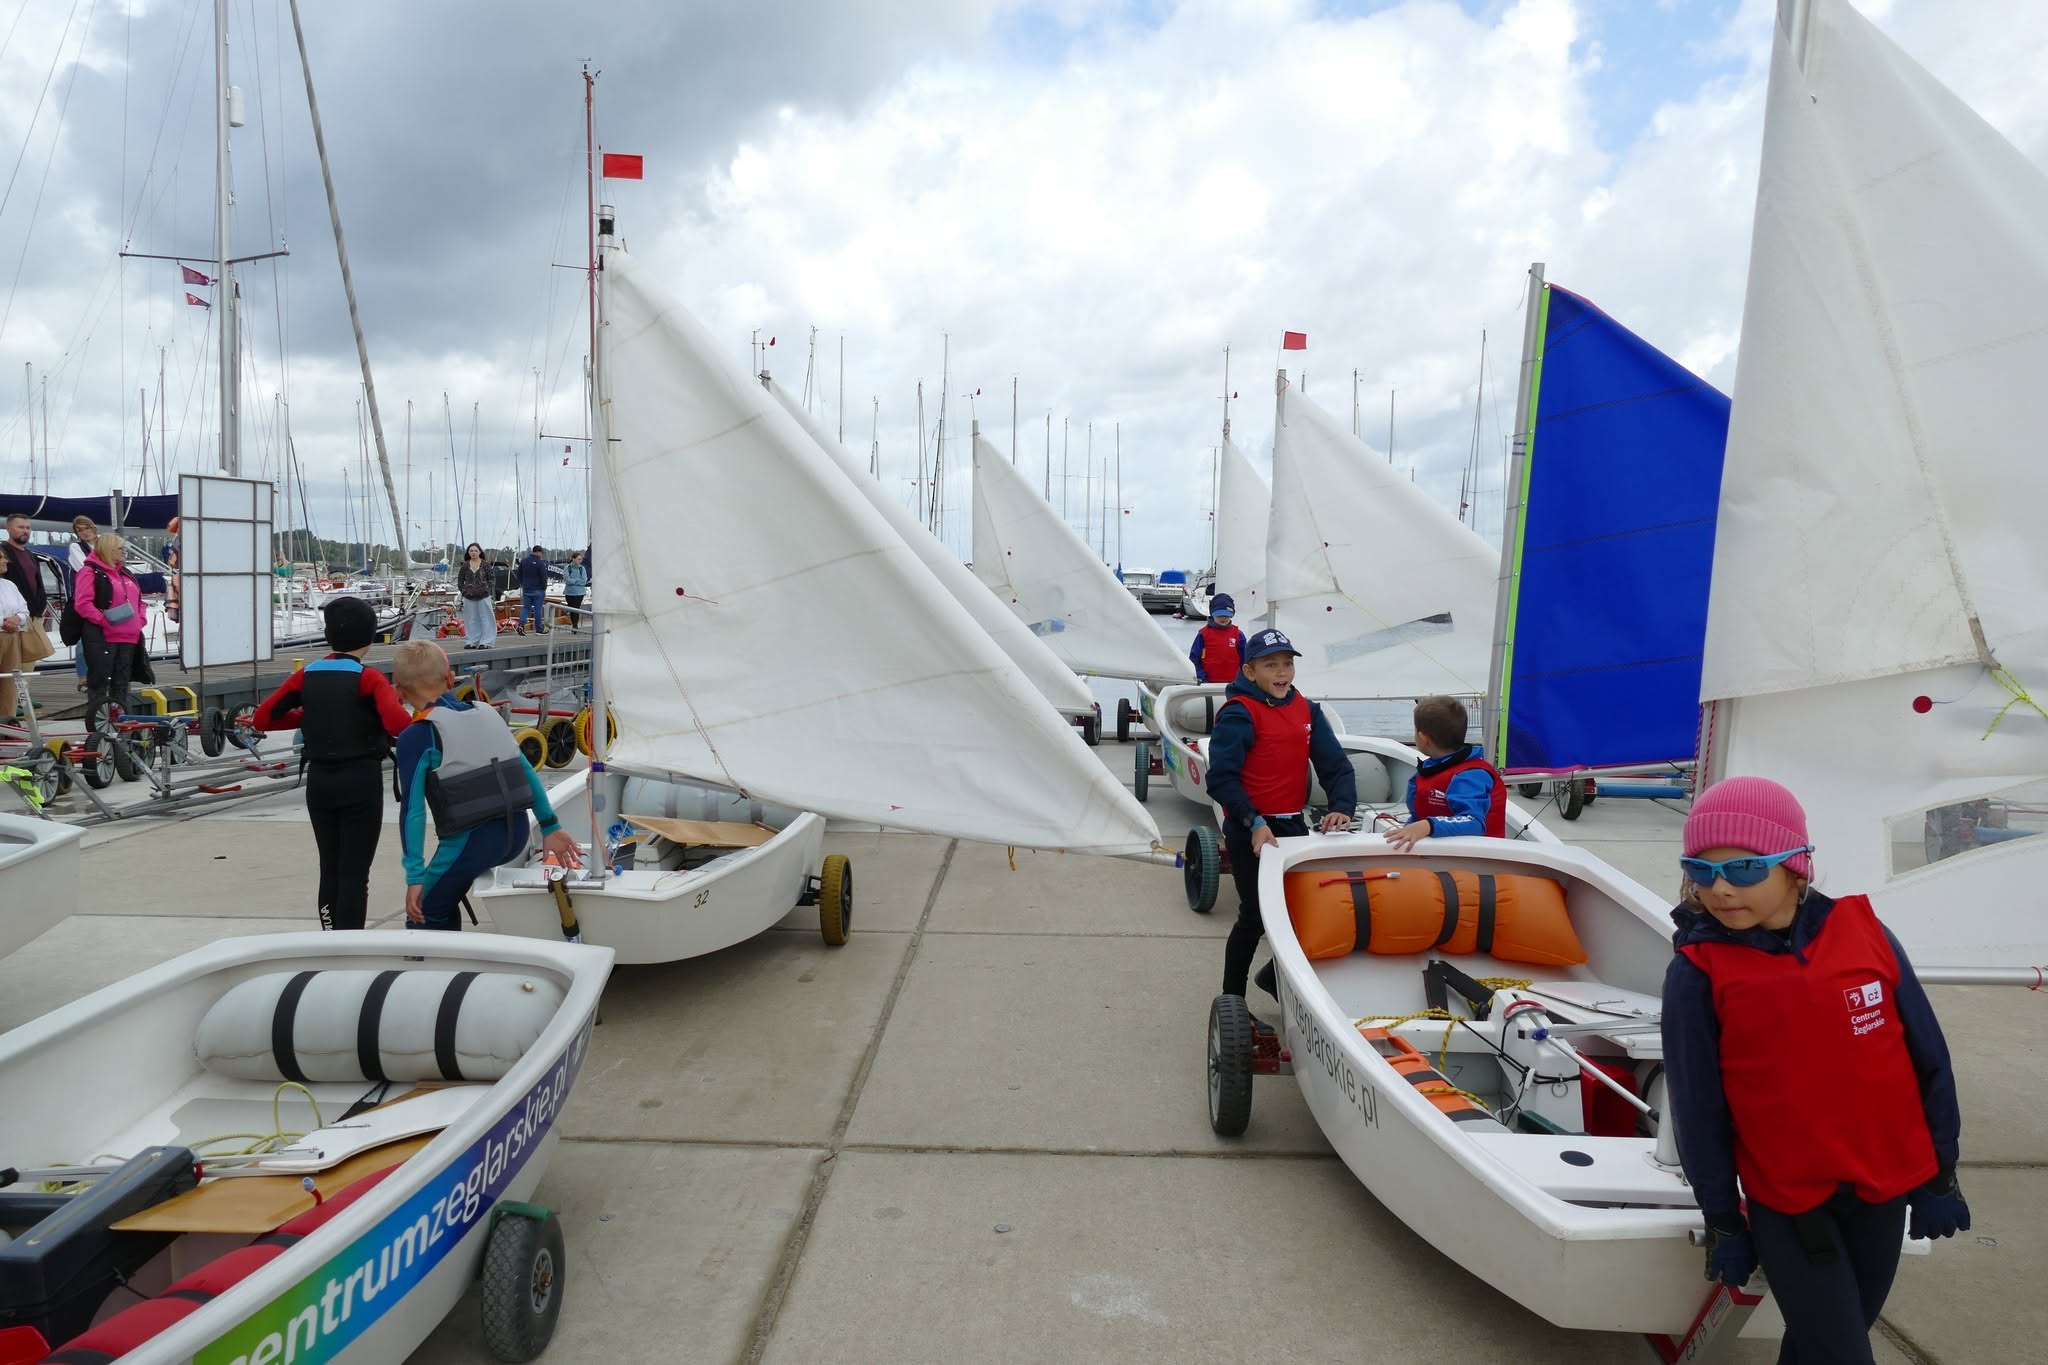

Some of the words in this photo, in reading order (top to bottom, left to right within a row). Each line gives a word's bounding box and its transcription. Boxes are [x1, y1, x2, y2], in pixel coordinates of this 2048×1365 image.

[1263, 631, 1288, 646] 23
[694, 889, 709, 908] 32
[1851, 1009, 1881, 1024] Centrum
[1853, 1018, 1885, 1036] Żeglarskie
[229, 1045, 570, 1365] entrumzeglarskie.pl
